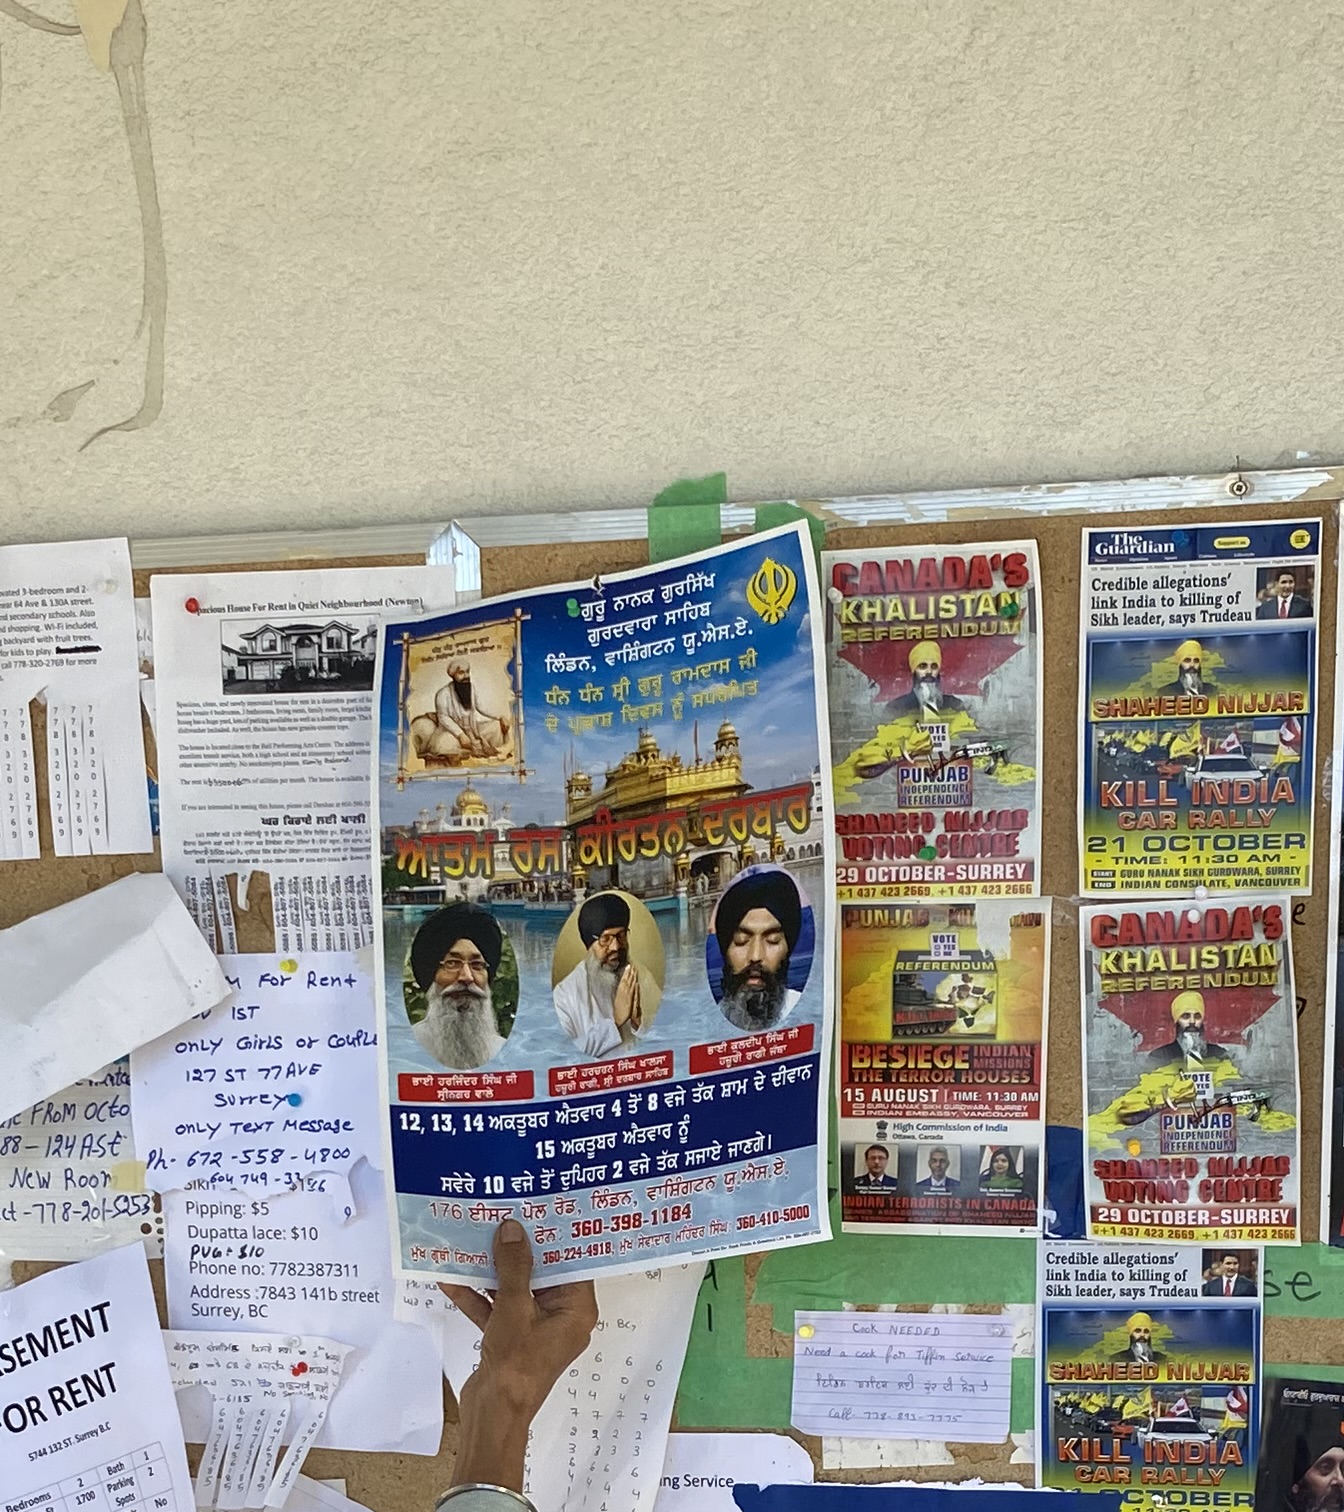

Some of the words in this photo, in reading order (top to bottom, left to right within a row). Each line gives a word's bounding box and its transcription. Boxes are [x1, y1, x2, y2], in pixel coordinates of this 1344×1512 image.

[1095, 540, 1175, 556] Guardian
[1111, 533, 1142, 546] The
[1091, 576, 1148, 591] Credible
[581, 600, 606, 622] ਗੁਰੂ
[613, 589, 655, 611] ਨਾਨਕ
[661, 572, 715, 602] ਗੁਰਸਿੱਖ
[1091, 595, 1117, 609] link
[1122, 594, 1156, 608] India
[1161, 596, 1175, 607] to
[1180, 592, 1222, 610] killing
[1227, 591, 1241, 605] of
[588, 615, 658, 647] ਗੁਰਦਵਾਰਾ
[664, 601, 711, 626] ਸਾਹਿਬ
[1091, 611, 1119, 626] Sikh
[1123, 611, 1165, 628] leader,
[1169, 613, 1195, 626] says
[1201, 609, 1252, 623] Trudeau
[544, 653, 597, 673] ਲਿੰਡਨ,
[605, 638, 675, 666] ਵਾਸ਼ਿੰਗਟਨ
[1093, 694, 1209, 718] SHAHEED
[1218, 691, 1305, 714] NIJJAR
[1100, 780, 1177, 808] KILL
[1193, 777, 1295, 805] INDIA
[507, 826, 565, 874] ਰਸ
[699, 781, 814, 846] ਦਰਬਾਰ
[1118, 810, 1177, 831] CAR
[1189, 808, 1276, 828] RALLY
[1087, 835, 1126, 853] 21
[1143, 833, 1306, 852] OCTOBER
[896, 962, 995, 971] REFERENDUM
[1100, 943, 1279, 974] KHALISTAN
[307, 972, 357, 989] Rent
[1099, 970, 1280, 993] REFERENDUM
[851, 1044, 970, 1069] BESIEGE
[853, 1070, 883, 1082] THE
[890, 1070, 955, 1083] TERROR
[961, 1070, 1030, 1084] HOUSES
[399, 1113, 425, 1134] 12,
[431, 1114, 456, 1135] 13,
[463, 1114, 484, 1132] 14
[488, 1111, 549, 1137] ਅਕਤੂਬਰ
[556, 1102, 606, 1125] ਐਤਵਾਰ
[611, 1100, 622, 1116] 4
[628, 1093, 642, 1114] ਤੋਂ
[648, 1093, 658, 1111] 8
[664, 1085, 686, 1108] ਵਜੇ
[692, 1081, 715, 1103] ਤੱਕ
[721, 1078, 748, 1098] ਸ਼ਾਮ
[754, 1071, 766, 1091] ਦੇ
[772, 1062, 813, 1087] ਦੀਵਾਨ
[844, 1088, 864, 1102] 15
[872, 1088, 939, 1102] AUGUST
[536, 1140, 555, 1159] 15
[186, 1202, 246, 1220] Pipping:
[251, 1202, 269, 1217] $5
[736, 1204, 810, 1230] 360-410-5000
[1098, 1208, 1120, 1222] 29
[571, 1202, 692, 1240] 360-398-1184
[188, 1225, 249, 1242] Dupatta
[252, 1225, 287, 1240] lace:
[291, 1226, 318, 1242] $10
[189, 1261, 237, 1276] Phone
[269, 1262, 359, 1278] 7782387311
[190, 1285, 250, 1300] Address
[300, 1286, 338, 1301] 141b
[342, 1289, 380, 1304] street
[192, 1303, 245, 1320] Surrey,
[248, 1304, 268, 1318] BC
[49, 1362, 117, 1416] RENT
[684, 1474, 734, 1488] Service
